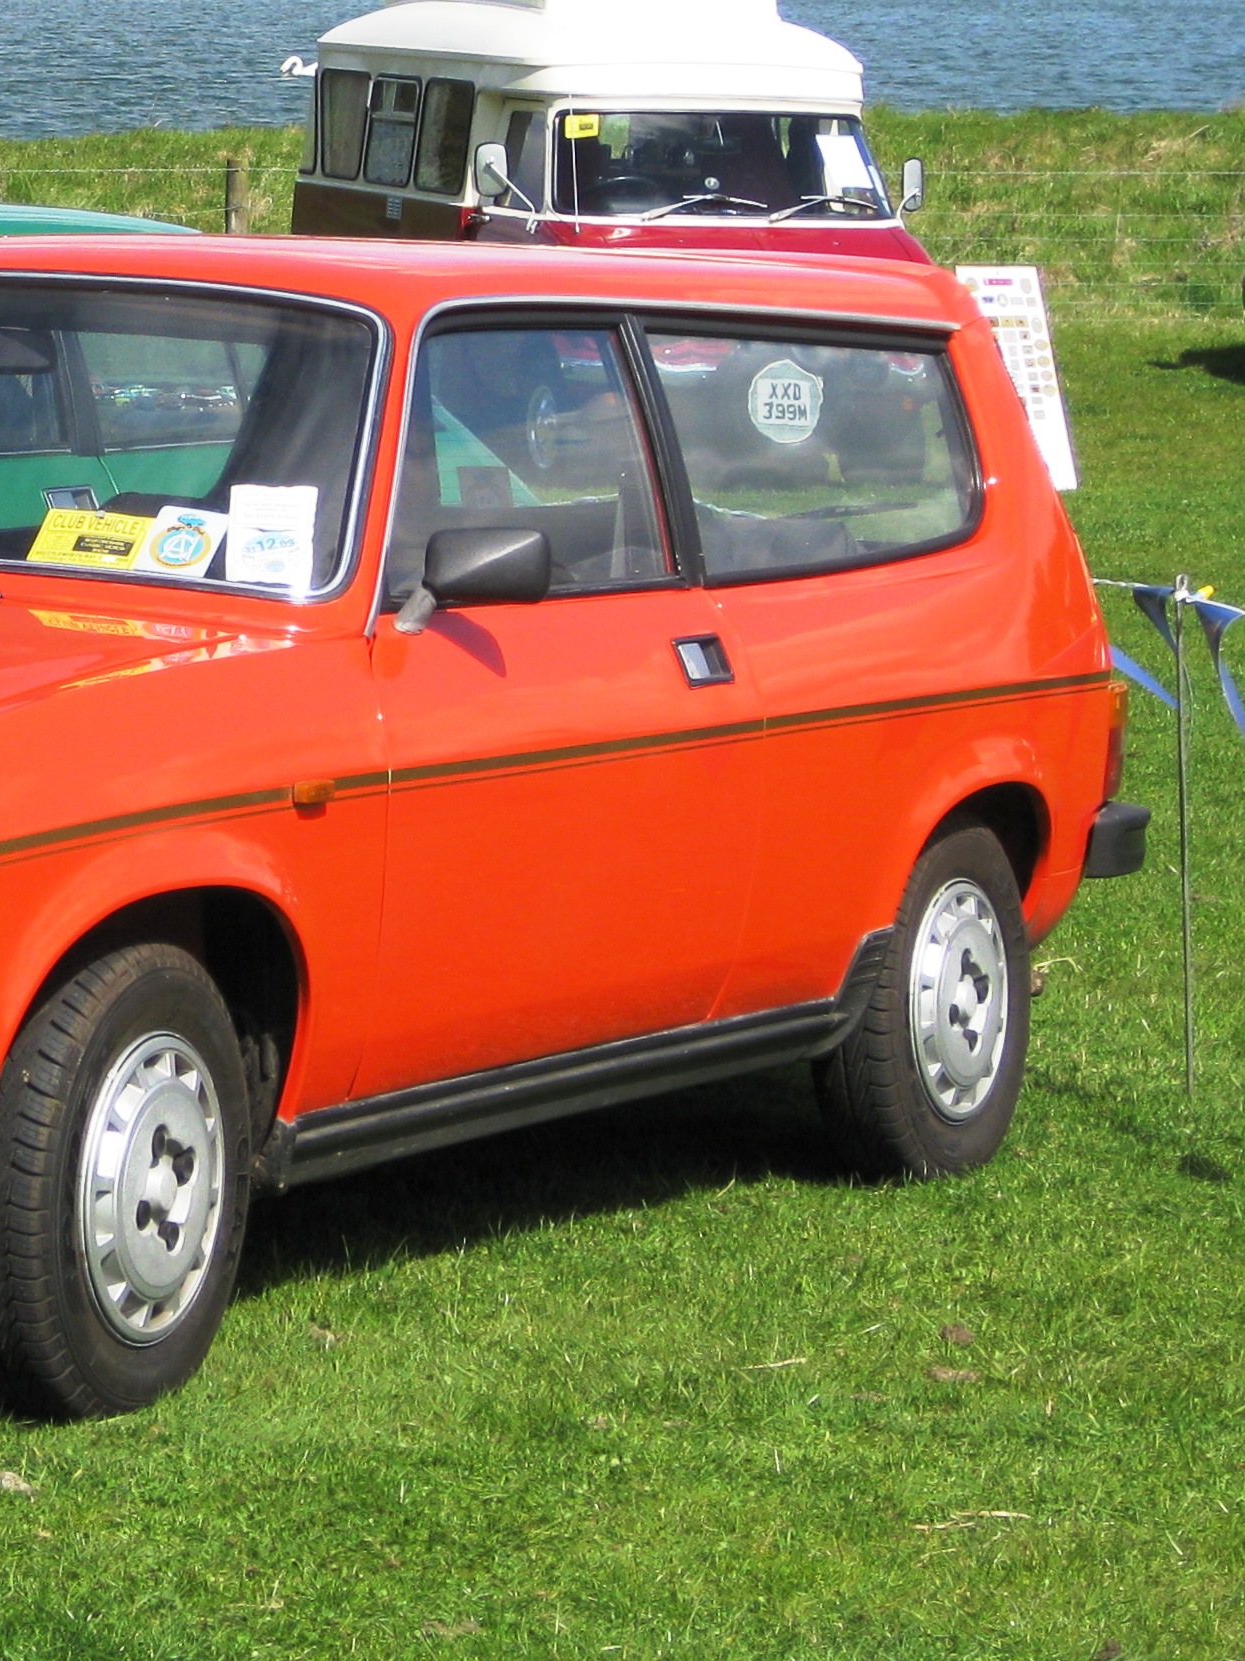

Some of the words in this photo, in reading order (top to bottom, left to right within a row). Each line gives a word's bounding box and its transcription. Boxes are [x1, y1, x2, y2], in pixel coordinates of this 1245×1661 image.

[52, 514, 86, 529] CLUB
[87, 516, 140, 535] VEHICLE
[256, 538, 276, 551] 12
